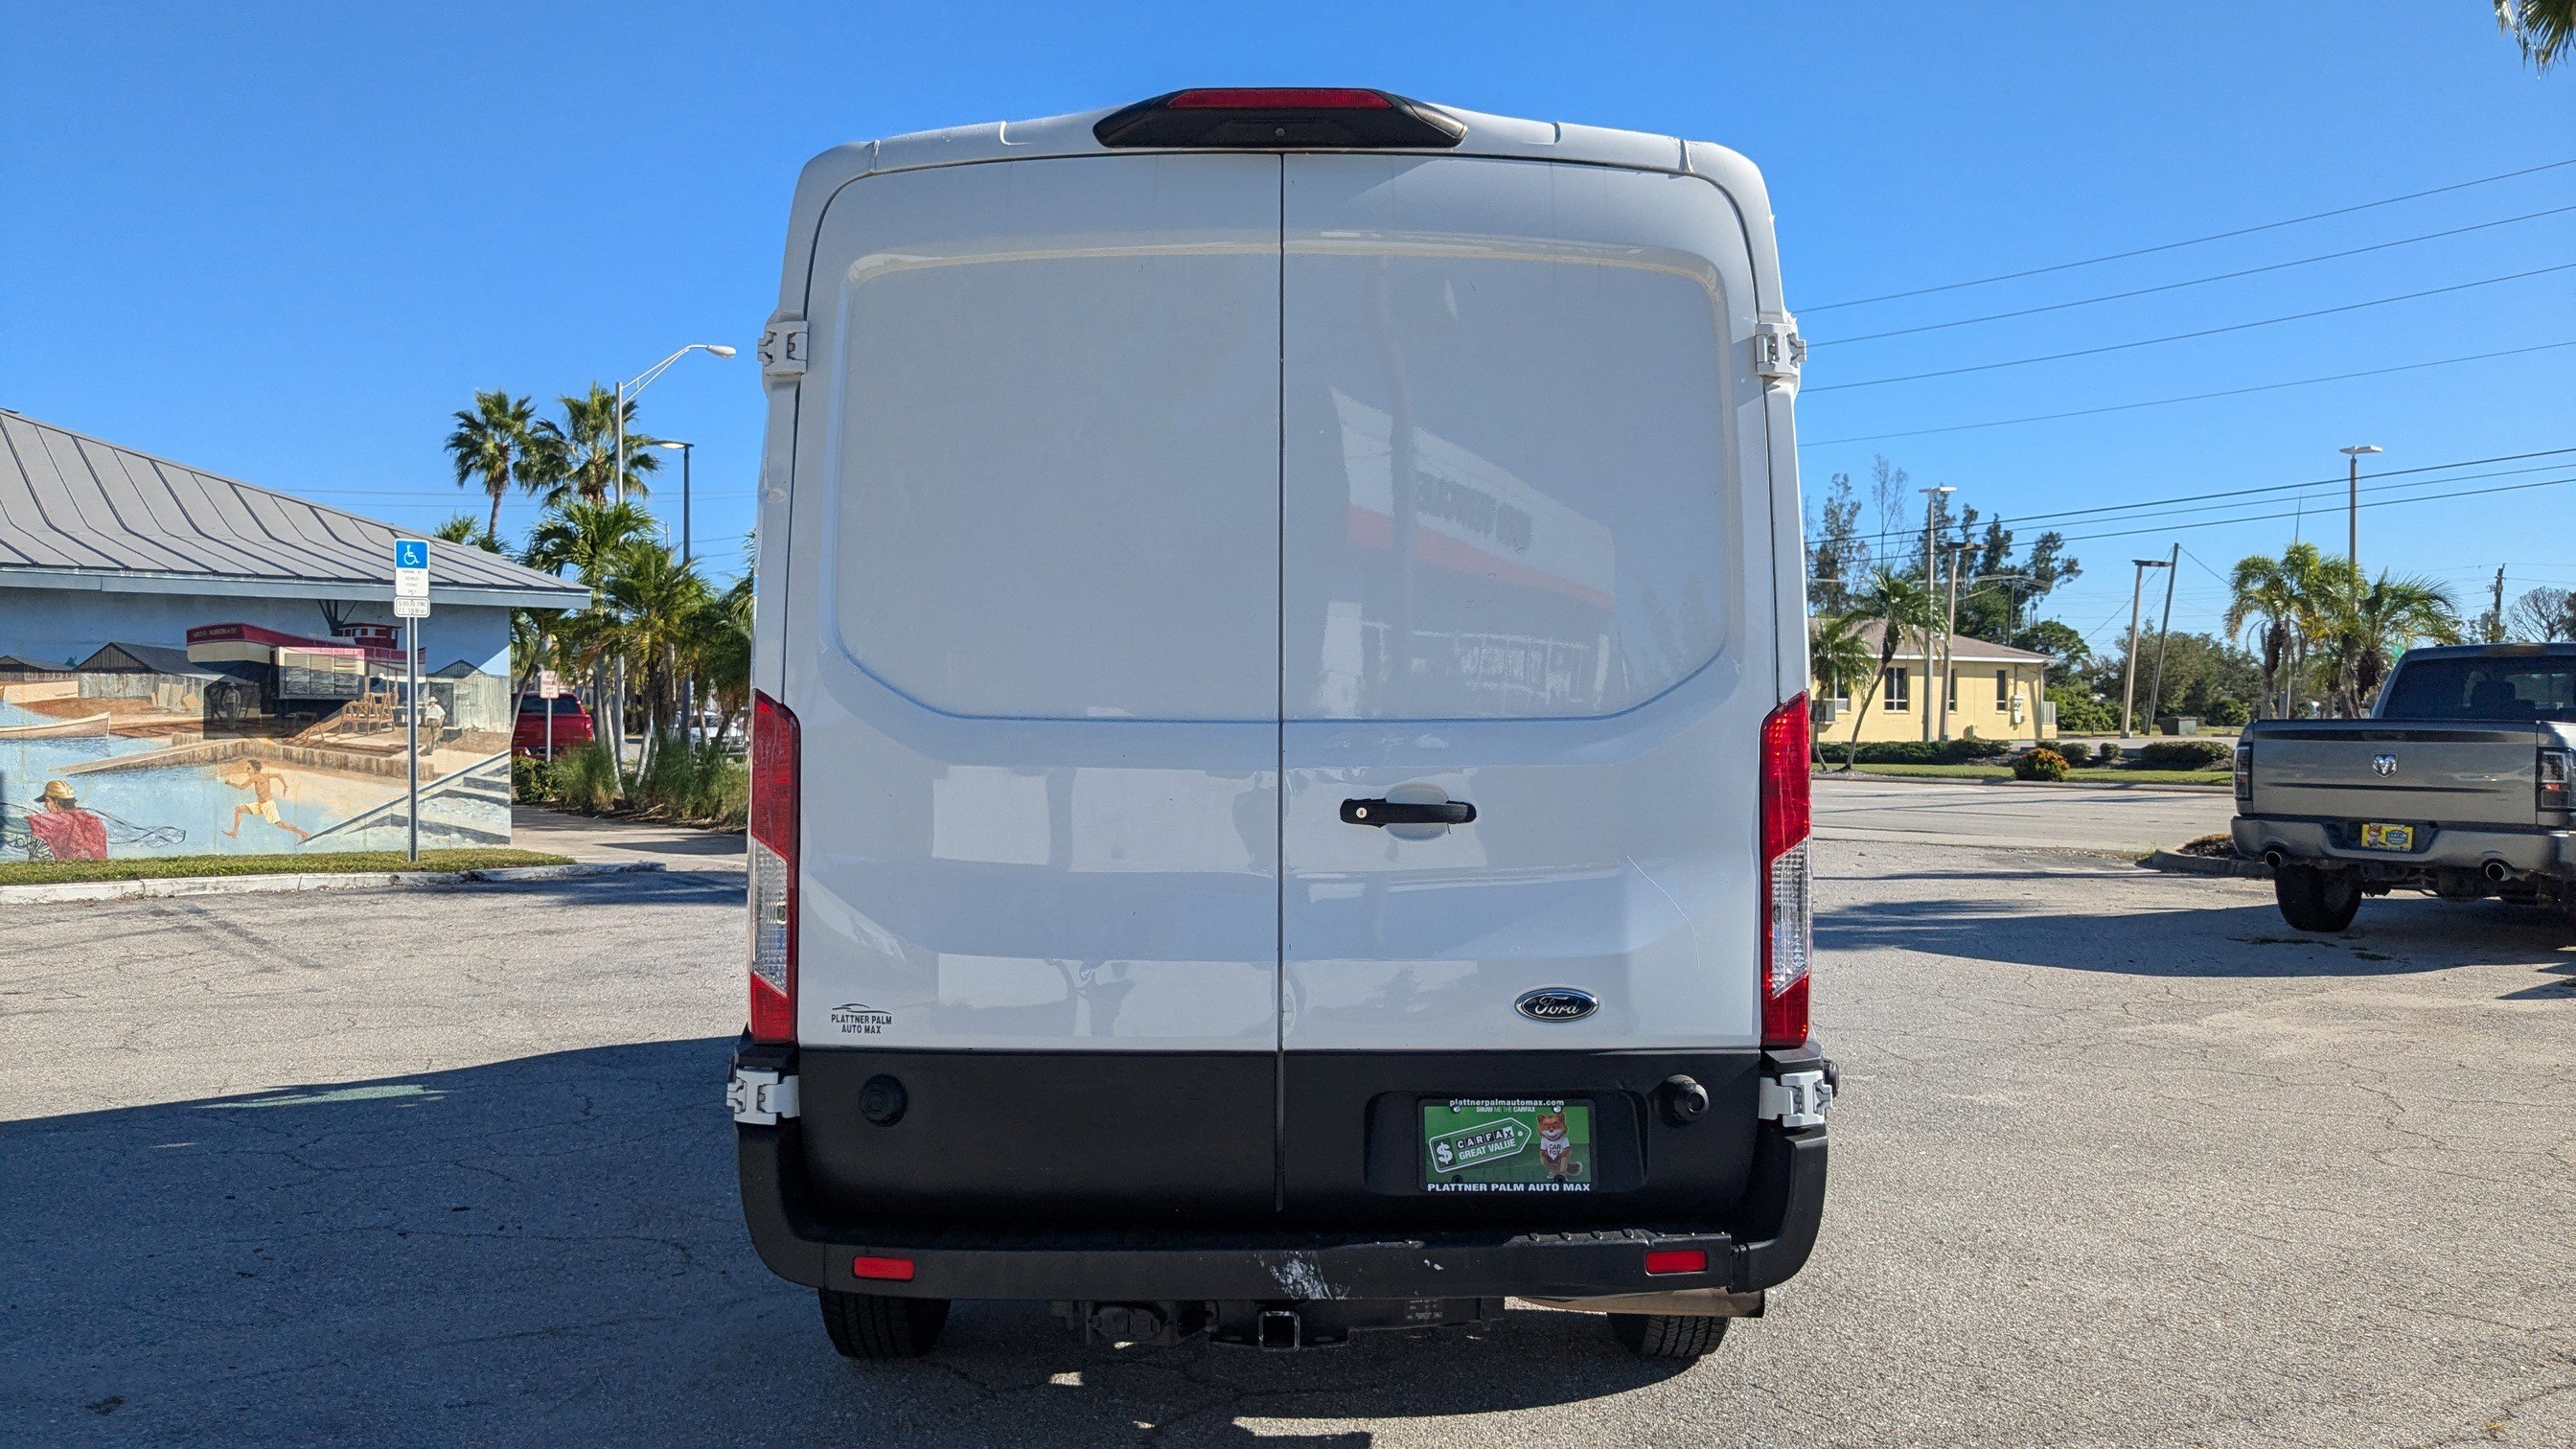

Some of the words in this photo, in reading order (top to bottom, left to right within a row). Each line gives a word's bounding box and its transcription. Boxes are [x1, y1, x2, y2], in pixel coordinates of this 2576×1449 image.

[1534, 996, 1580, 1015] Ford
[831, 1014, 870, 1024] PLATTNER
[871, 1016, 892, 1025] PALM
[841, 1024, 862, 1034] AUTO
[863, 1024, 882, 1035] MAX
[1449, 1098, 1565, 1108] plattnerpalmautomax.com
[1456, 1126, 1515, 1150] CARFAX
[1459, 1145, 1486, 1161] GREAT
[1487, 1138, 1517, 1153] VALUE
[1427, 1183, 1487, 1192] PLATTNER
[1491, 1183, 1525, 1192] PALM
[1528, 1183, 1560, 1192] AUTO
[1563, 1183, 1591, 1192] MAX
